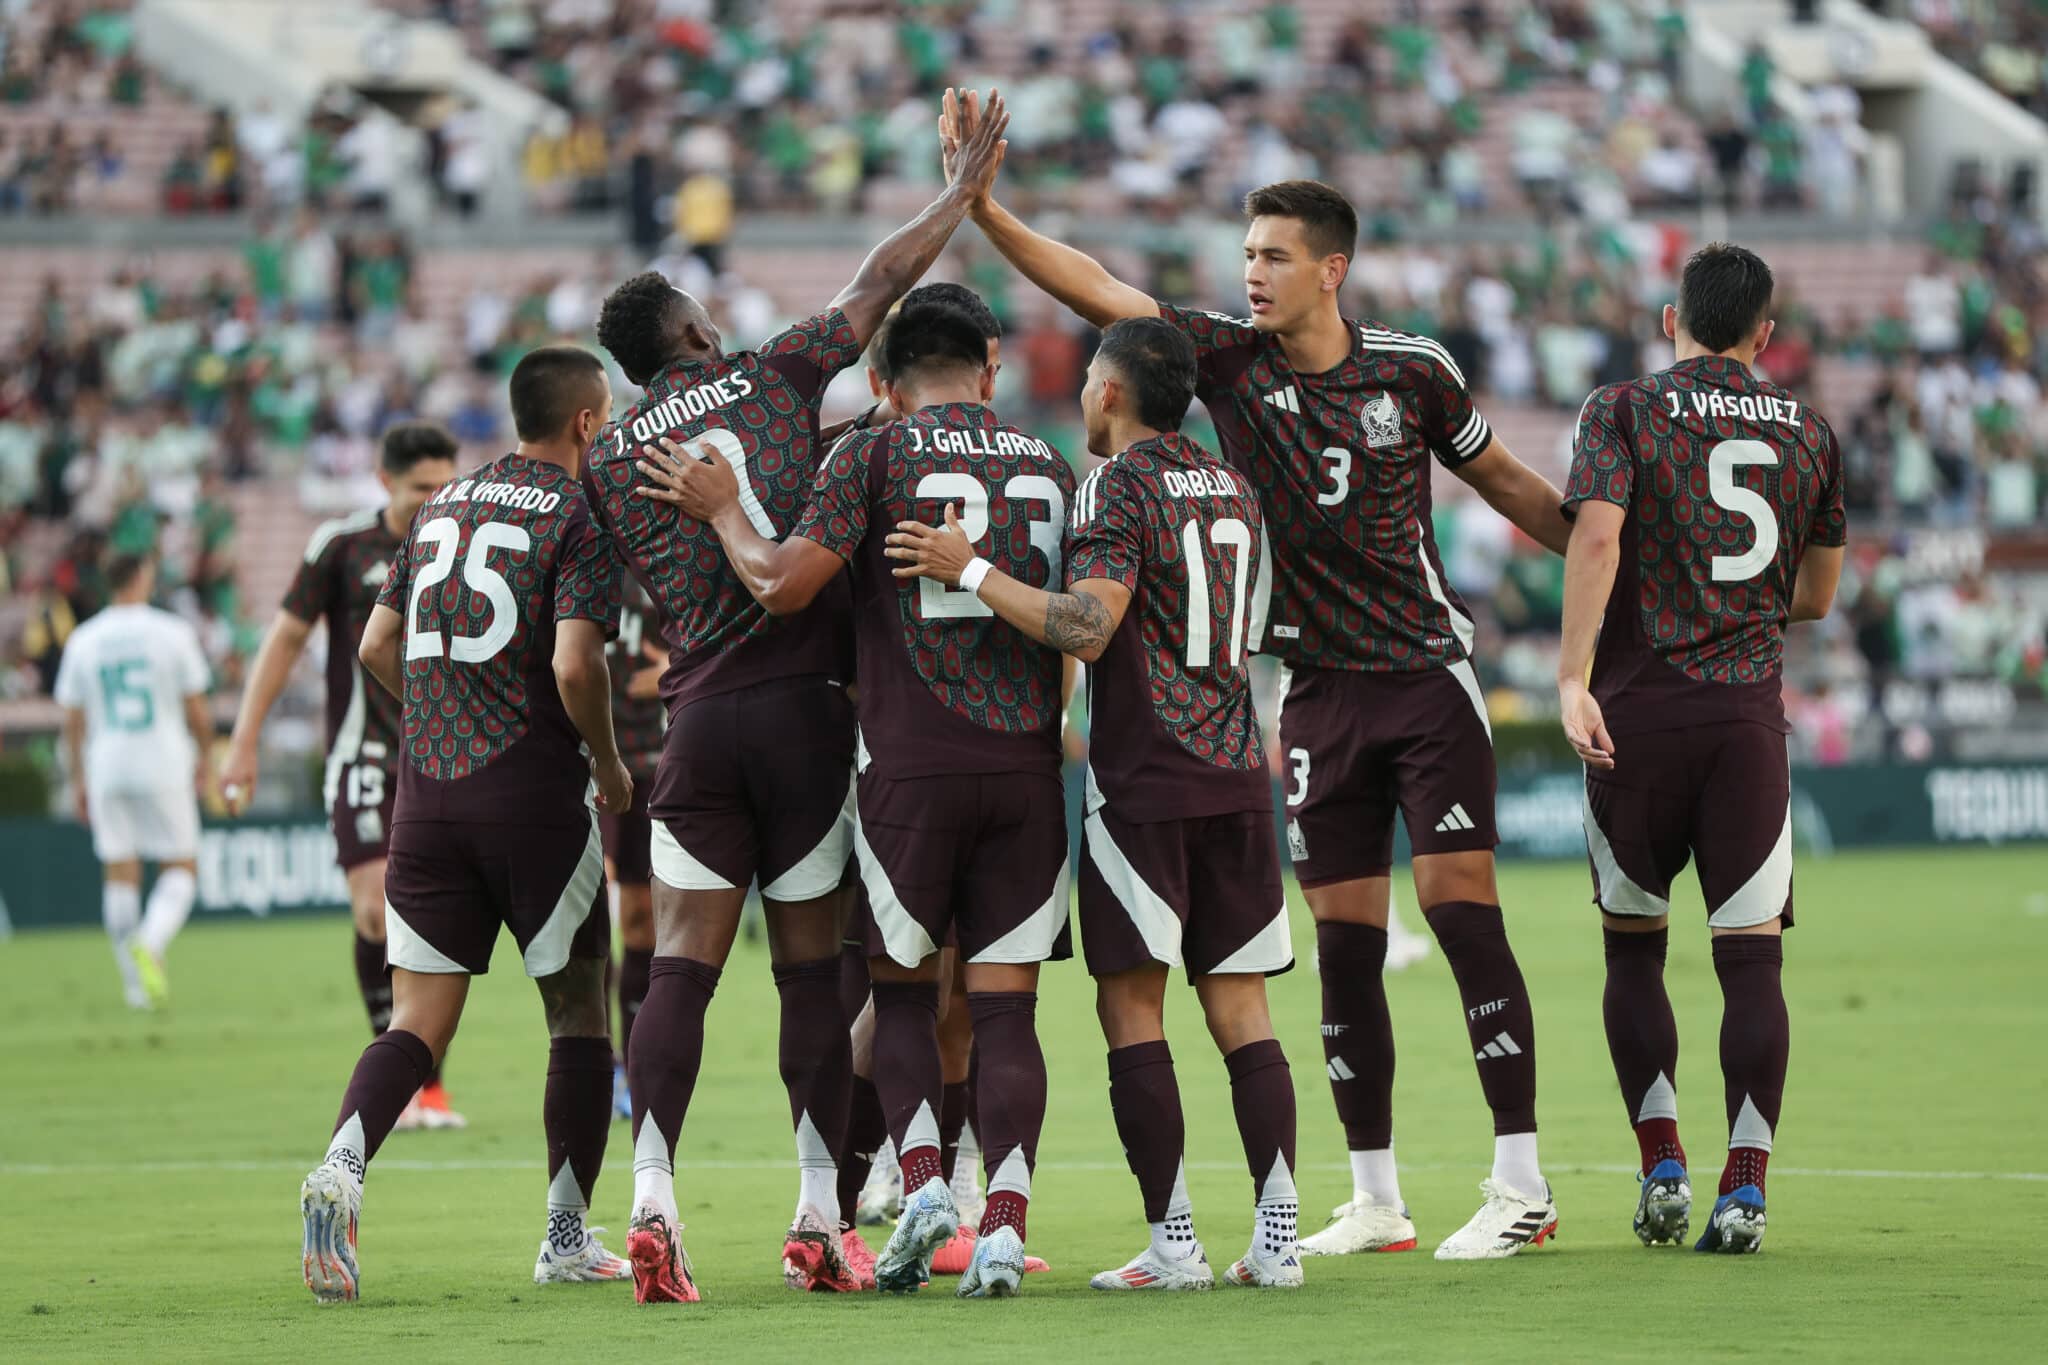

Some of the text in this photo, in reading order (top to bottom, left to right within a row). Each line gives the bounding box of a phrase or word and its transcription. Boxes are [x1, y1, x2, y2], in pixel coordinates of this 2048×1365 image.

[1691, 389, 1801, 427] VÁSQUEZ
[1317, 446, 1351, 506] 3
[1708, 439, 1779, 581] 5
[405, 516, 531, 664] 25
[1183, 518, 1251, 667] 17
[1286, 747, 1311, 807] 3
[1469, 998, 1510, 1020] FMF
